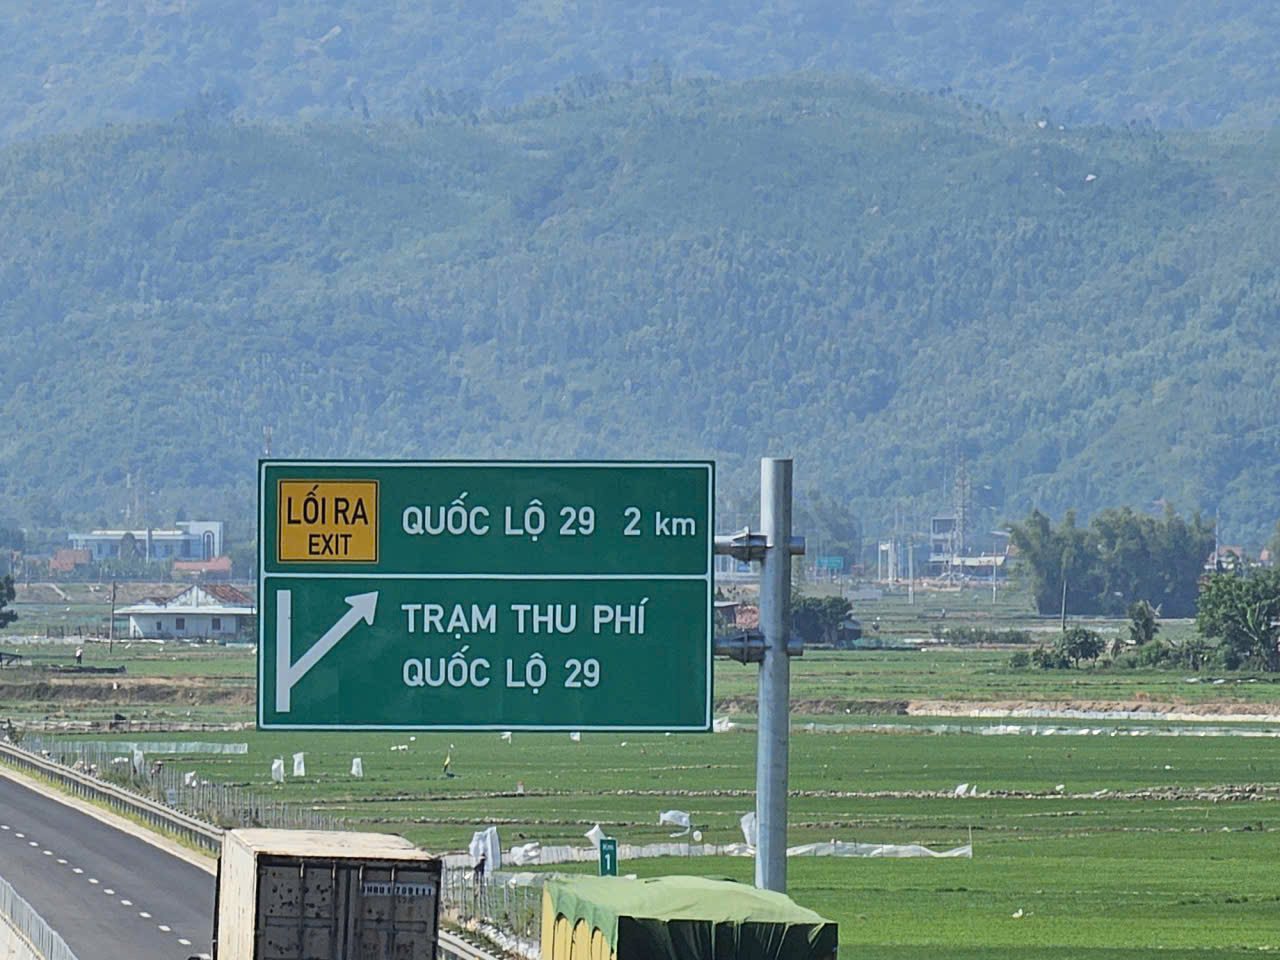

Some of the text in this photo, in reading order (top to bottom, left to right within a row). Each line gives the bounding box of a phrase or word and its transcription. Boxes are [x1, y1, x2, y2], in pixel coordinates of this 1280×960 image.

[286, 485, 369, 525] LỐI RA
[402, 491, 696, 543] QUỐC LỘ 29 2 km
[308, 533, 353, 556] EXIT
[402, 597, 649, 640] TRẠM THU PHÍ
[402, 645, 601, 695] QUỐC LỘ 29
[604, 853, 611, 870] 1
